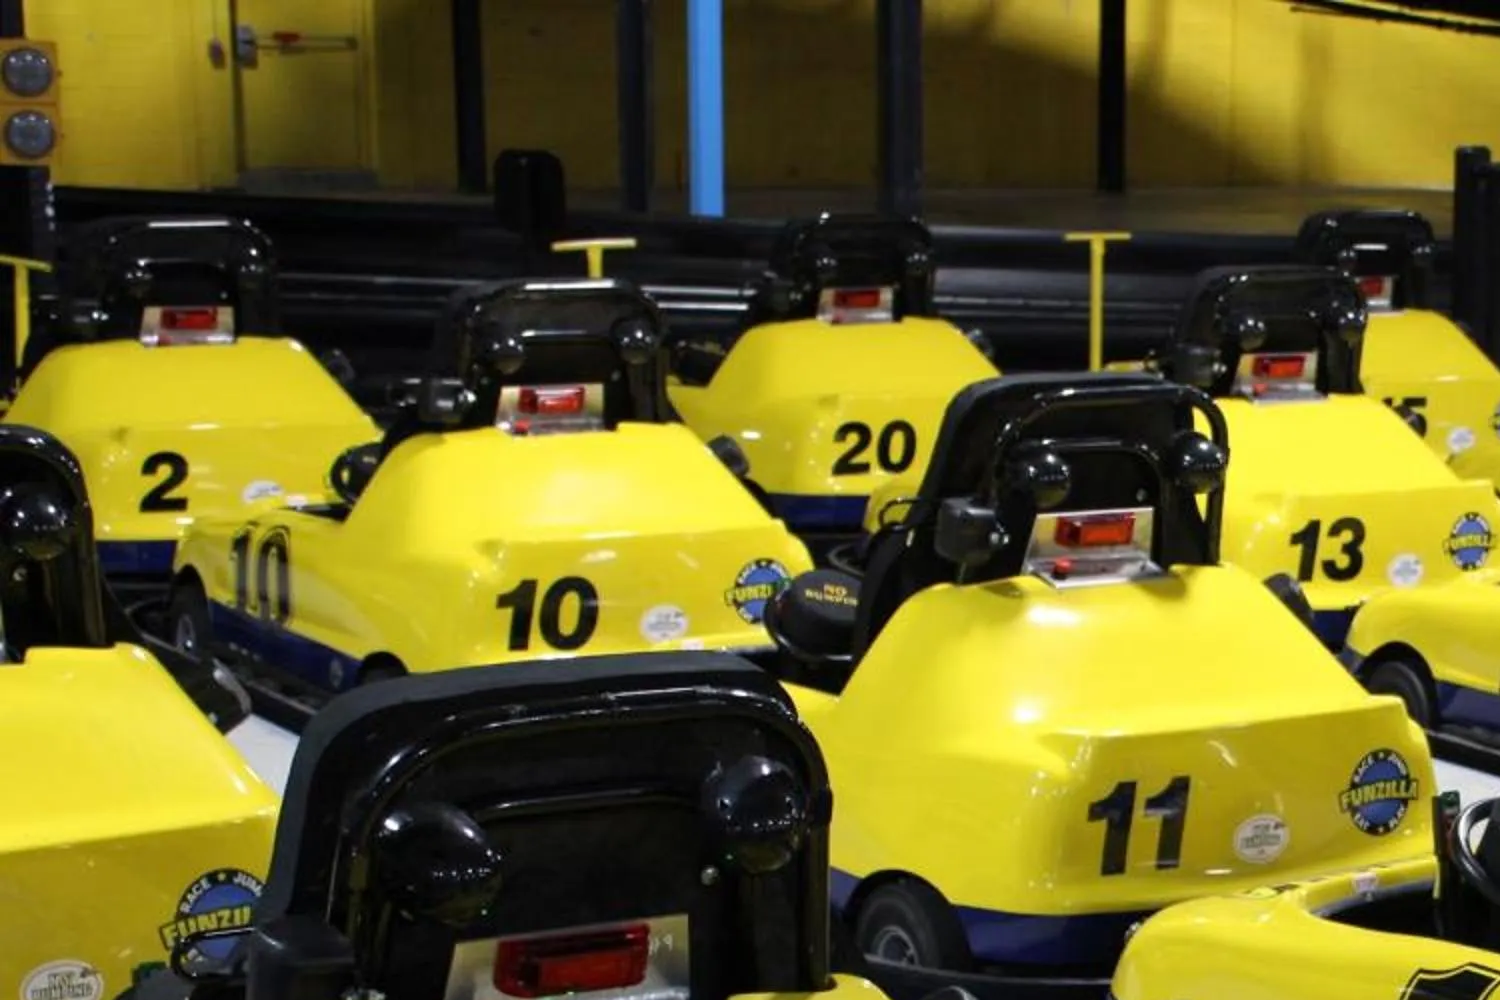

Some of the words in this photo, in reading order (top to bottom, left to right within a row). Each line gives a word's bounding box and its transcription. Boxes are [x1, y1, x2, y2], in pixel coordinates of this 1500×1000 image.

[1382, 397, 1427, 438] 5
[833, 421, 917, 476] 20
[140, 452, 188, 513] 2
[229, 520, 292, 624] 10
[1291, 518, 1364, 582] 13
[497, 577, 599, 651] 10
[1341, 779, 1417, 811] FUNZILLA
[1088, 776, 1190, 877] 11
[180, 877, 212, 913] RACE
[233, 872, 262, 897] JUM
